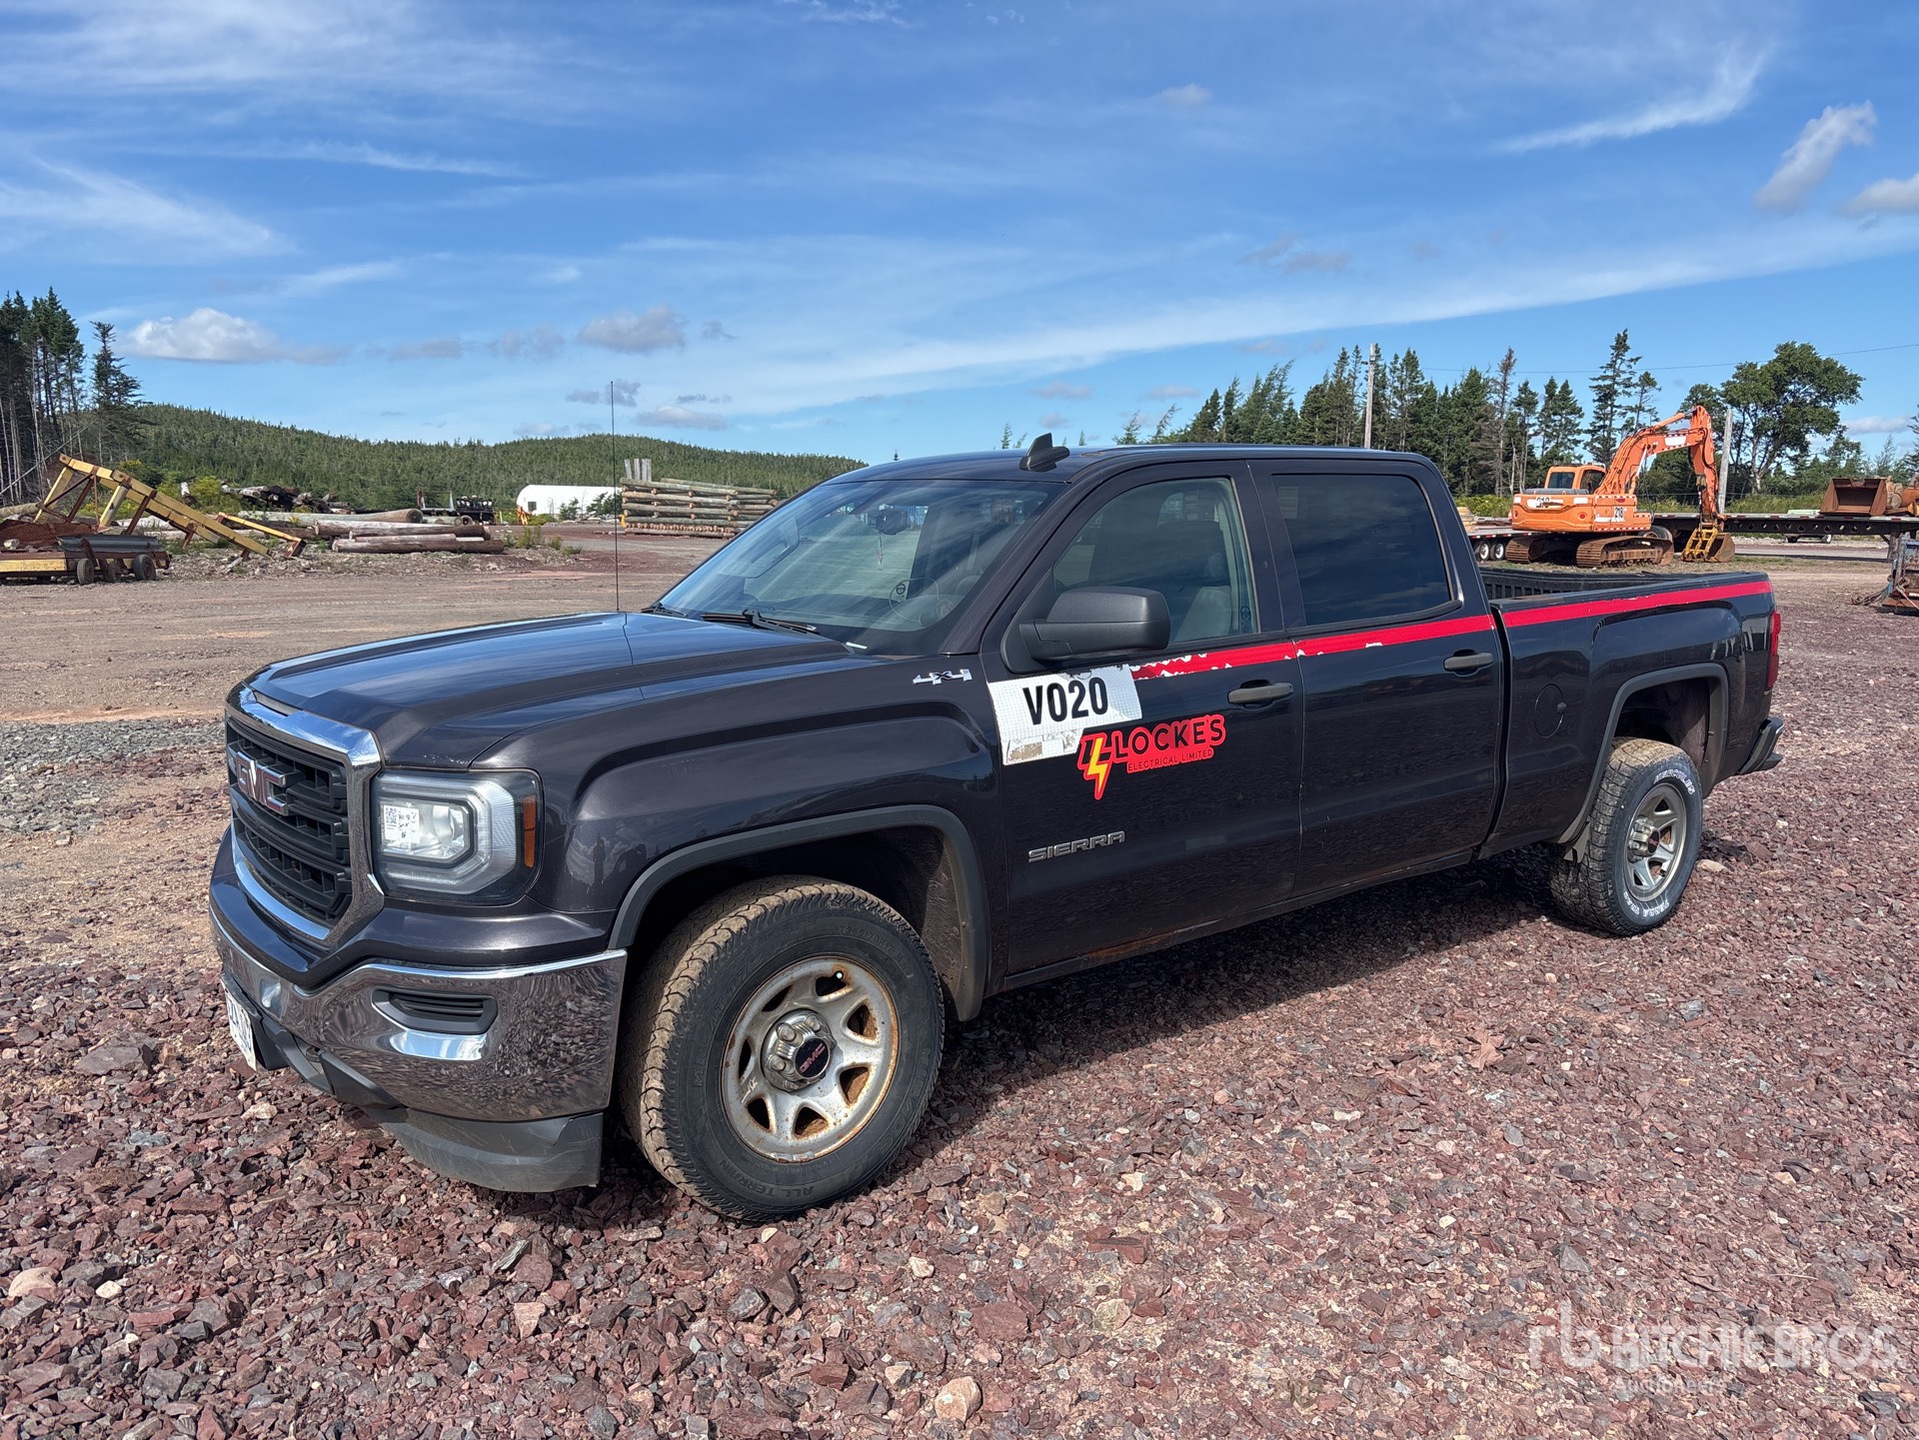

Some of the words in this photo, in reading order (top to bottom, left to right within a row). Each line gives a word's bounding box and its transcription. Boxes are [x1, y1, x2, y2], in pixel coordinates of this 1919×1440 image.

[1128, 755, 1179, 772] ELECTRICAL
[1181, 749, 1213, 762] LIMITED
[236, 751, 289, 817] GMC
[1028, 831, 1125, 863] SIERRA
[799, 1042, 826, 1073] GMC
[720, 1160, 776, 1197] TERRAIN
[782, 1185, 814, 1198] ALL
